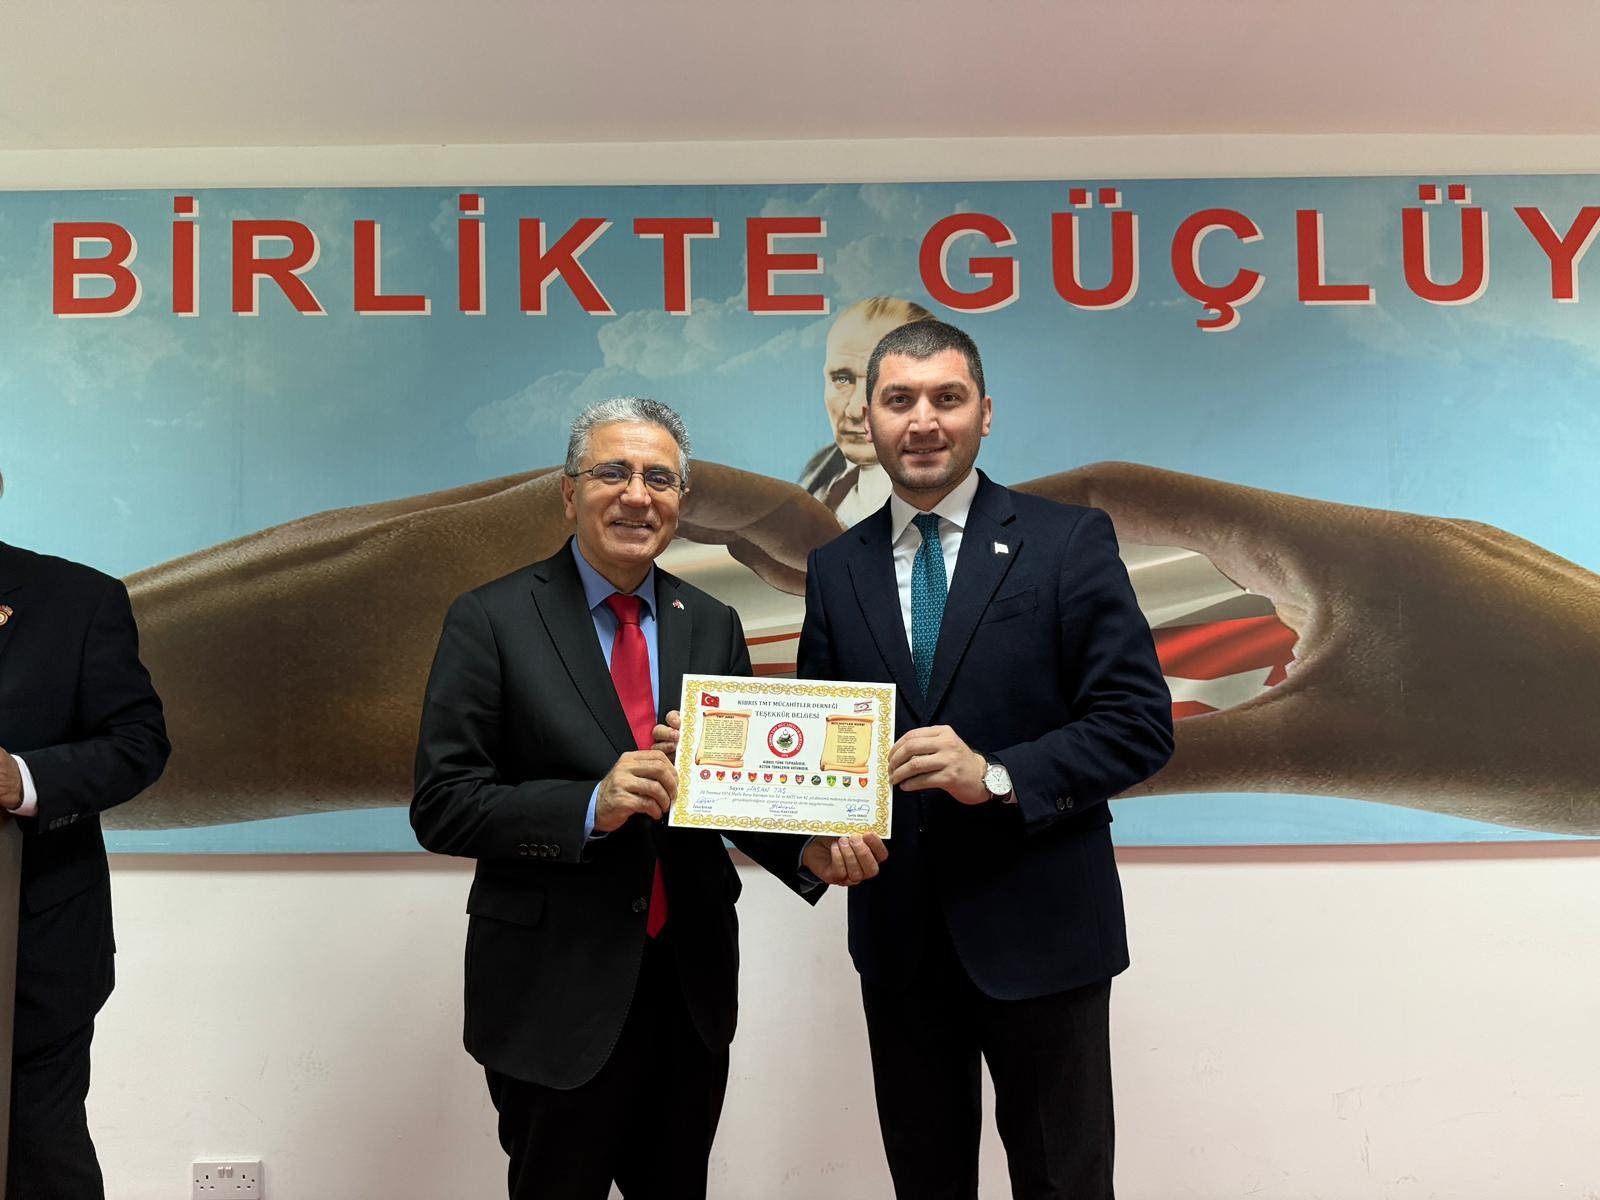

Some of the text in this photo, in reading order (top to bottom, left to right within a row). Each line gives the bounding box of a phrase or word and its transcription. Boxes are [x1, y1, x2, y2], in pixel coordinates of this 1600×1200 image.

[52, 183, 1600, 332] BİRLİKTE GÜÇLÜY
[773, 701, 811, 709] MÜCAHİTLER
[755, 710, 790, 719] TEŞEKKÜR
